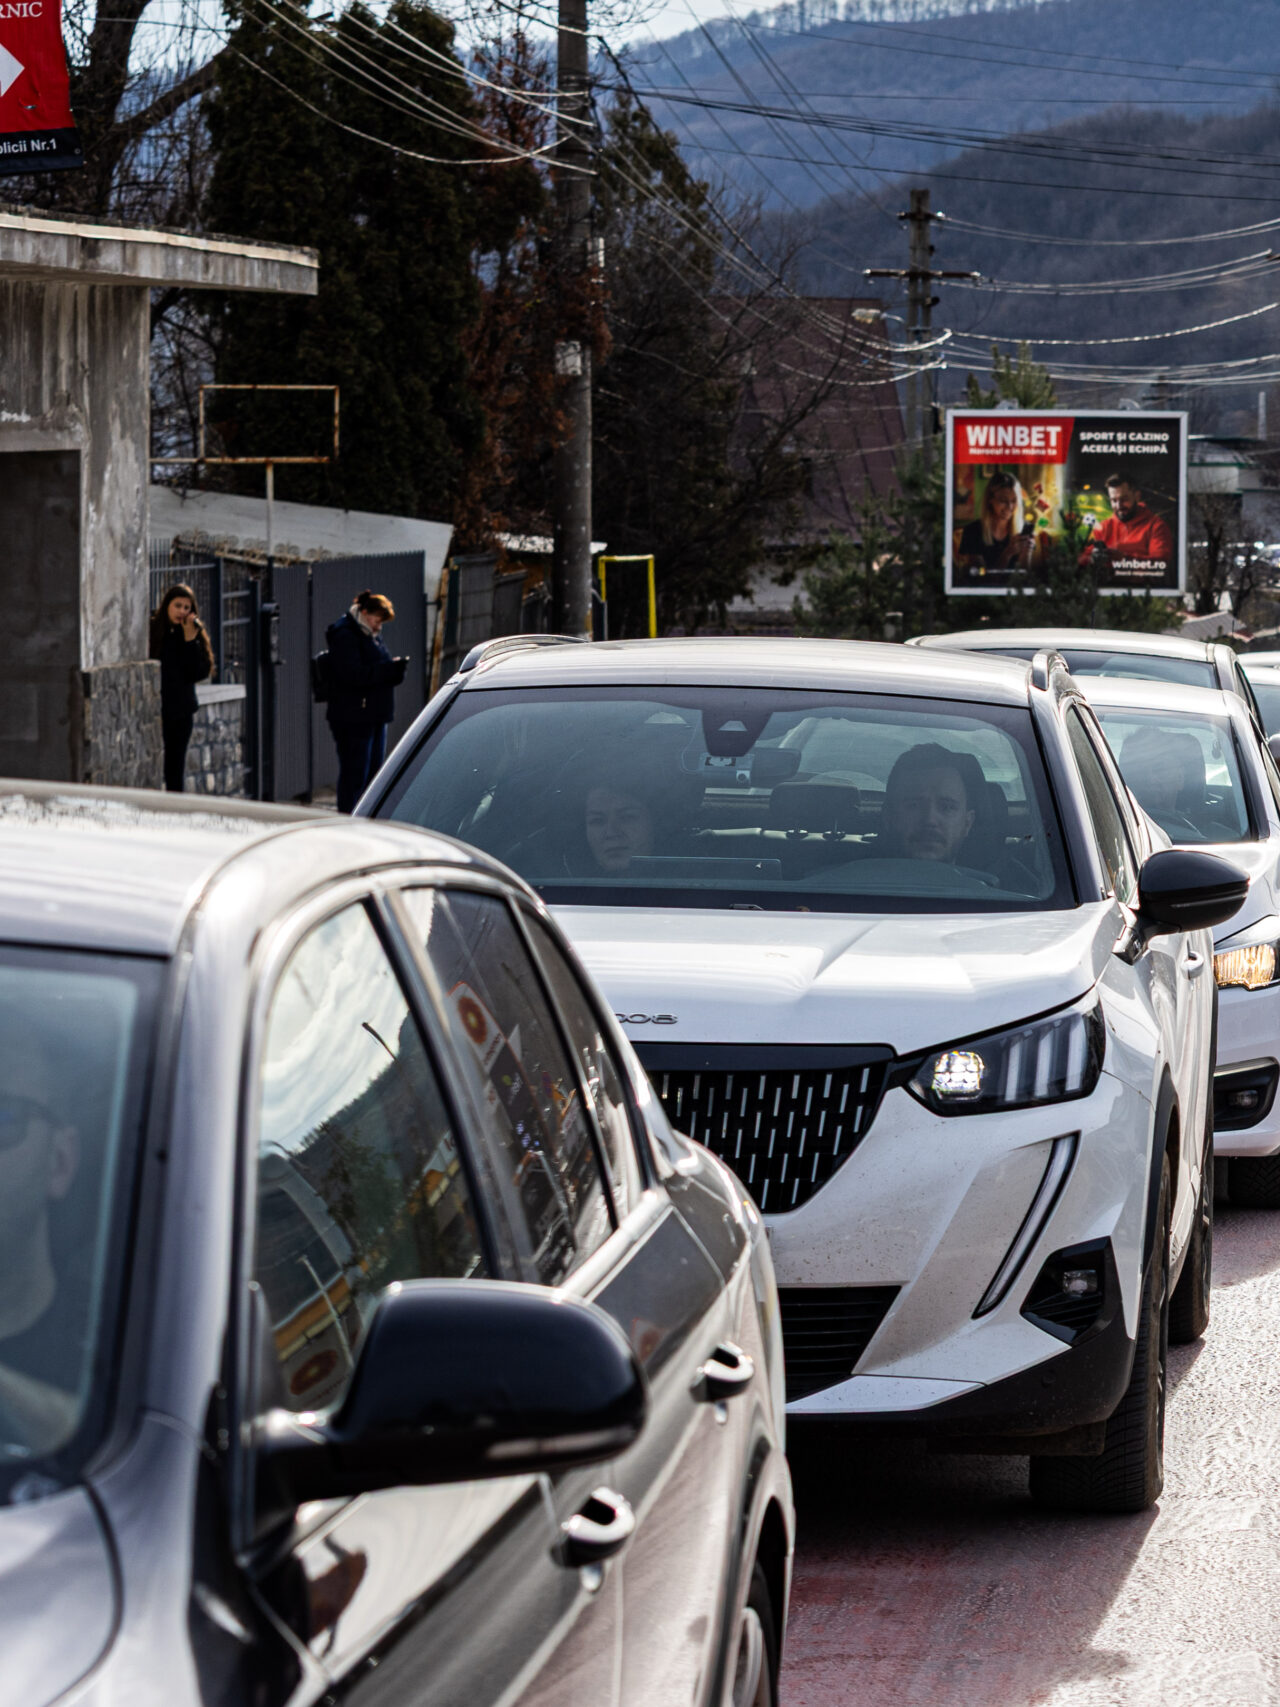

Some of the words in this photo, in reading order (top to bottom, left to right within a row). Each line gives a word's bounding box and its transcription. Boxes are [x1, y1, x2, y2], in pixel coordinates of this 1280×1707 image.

[31, 138, 57, 151] Nr.1
[966, 425, 1062, 447] WINBET
[1079, 431, 1115, 441] SPORT
[1128, 432, 1170, 441] CAZINO
[1128, 443, 1169, 454] ECHIPĂ
[1112, 558, 1167, 569] winbet.ro
